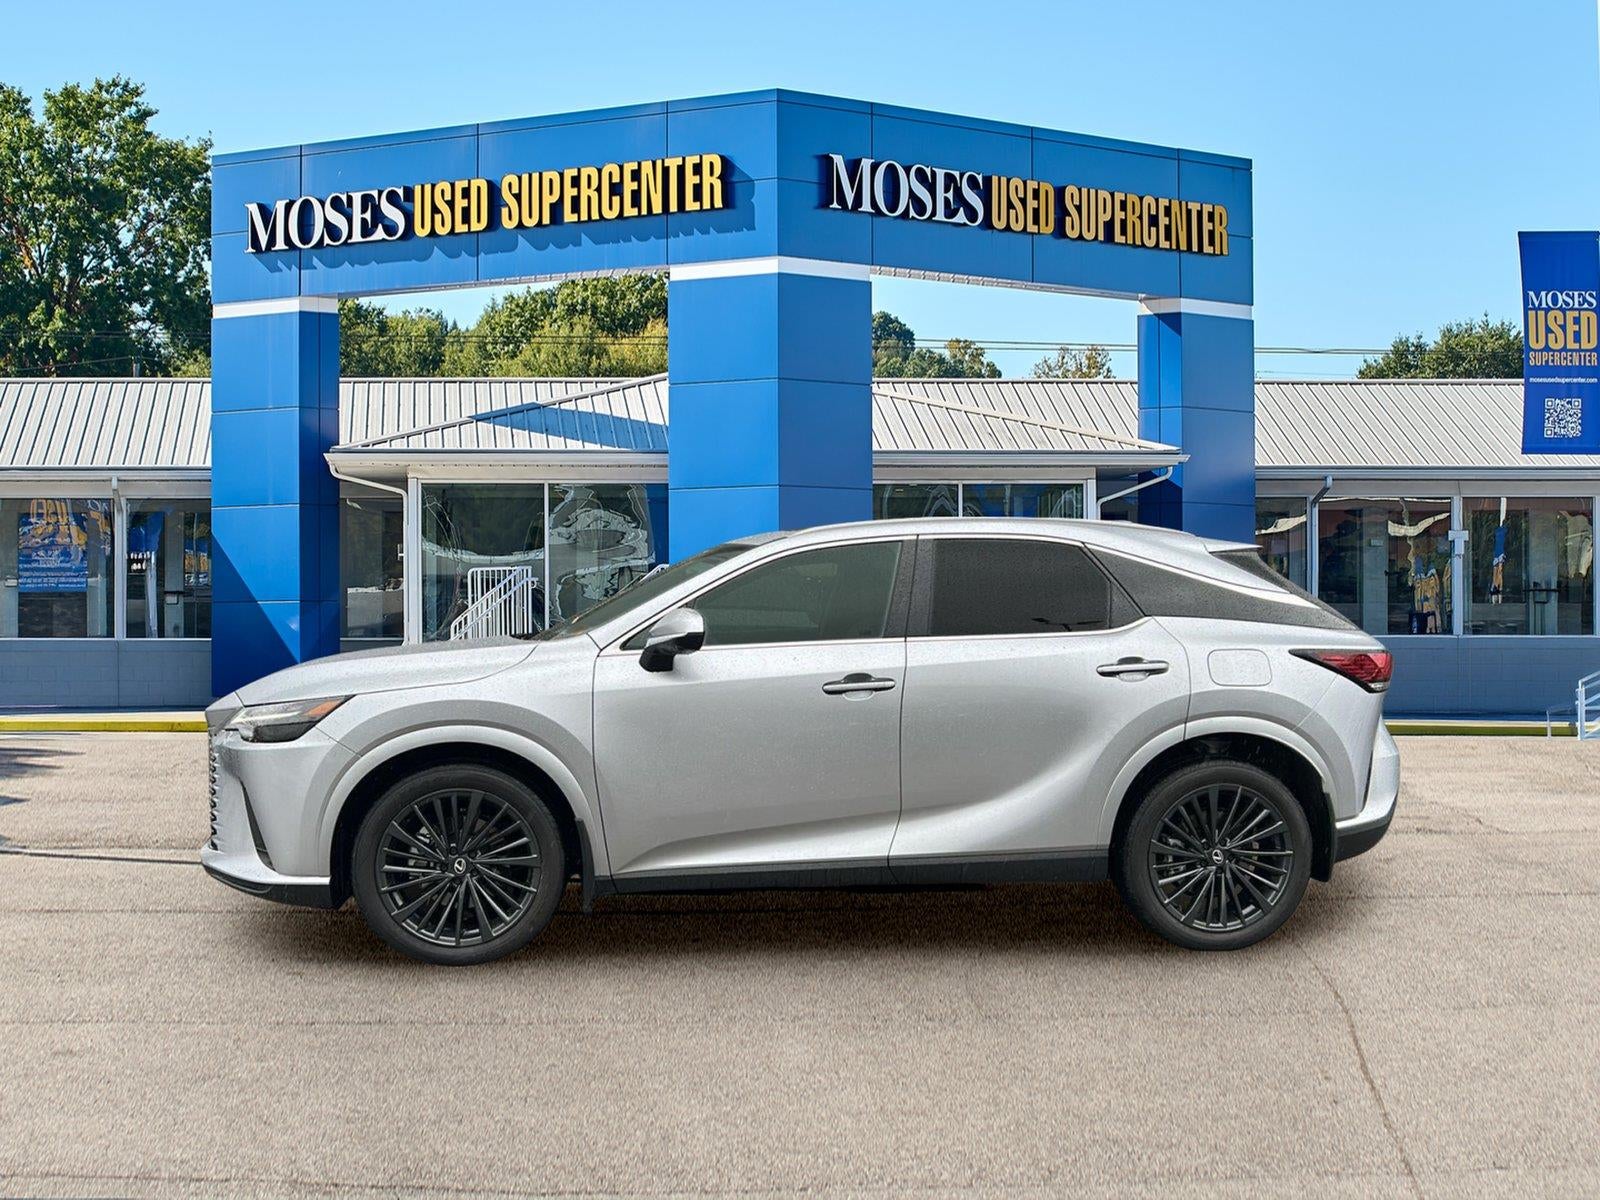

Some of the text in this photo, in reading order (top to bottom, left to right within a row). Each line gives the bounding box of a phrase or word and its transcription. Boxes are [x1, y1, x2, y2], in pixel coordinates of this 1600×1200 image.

[245, 153, 724, 254] MOSES USED SUPERCENTER
[828, 153, 1229, 256] MOSES USED SUPERCENTER
[1527, 290, 1597, 309] MOSES
[1528, 310, 1597, 350] USED
[1529, 352, 1598, 366] SUPERCENTER
[1529, 376, 1598, 384] mosesusedsupercenter.com
